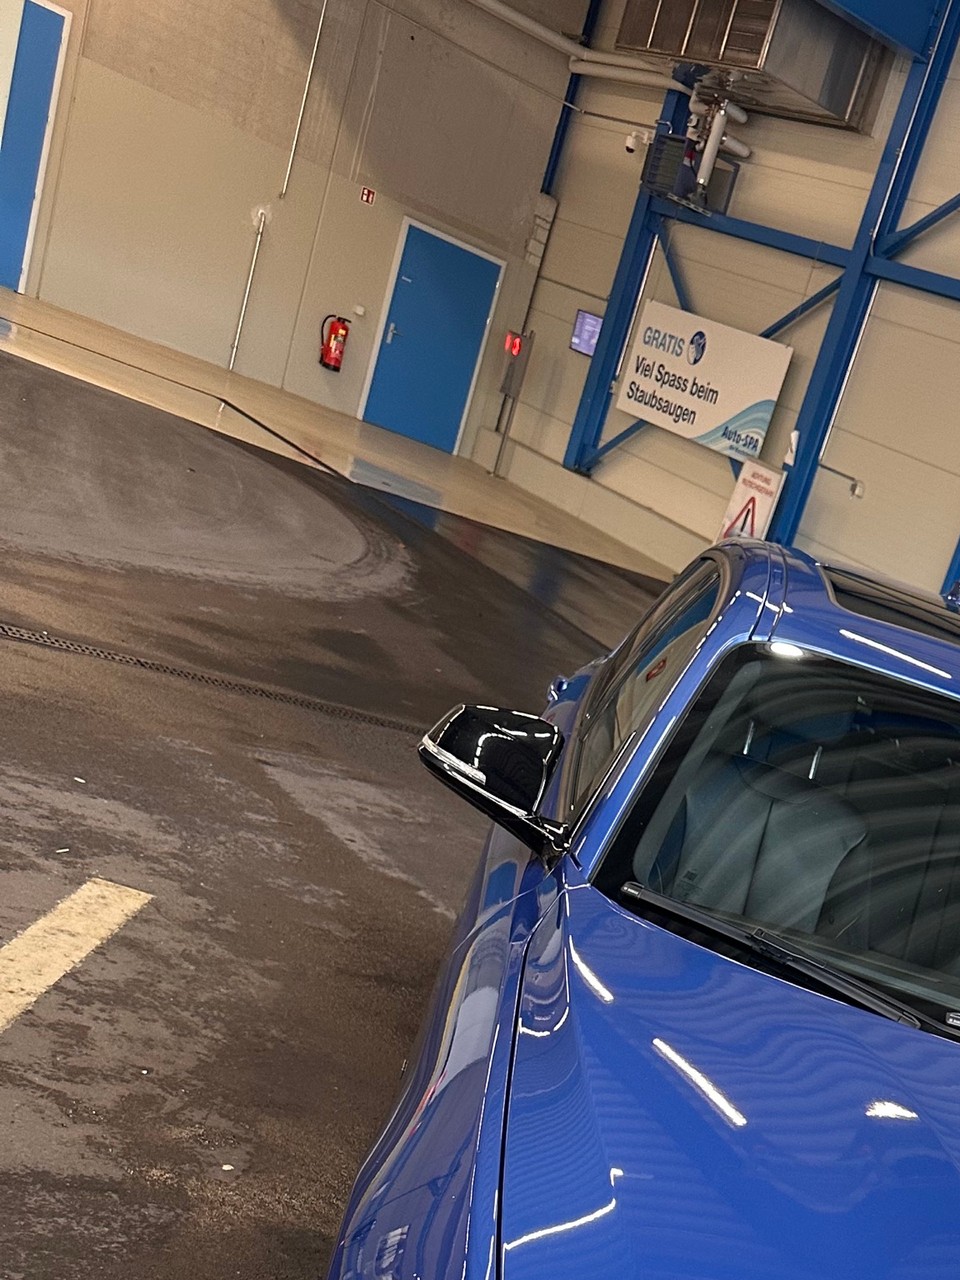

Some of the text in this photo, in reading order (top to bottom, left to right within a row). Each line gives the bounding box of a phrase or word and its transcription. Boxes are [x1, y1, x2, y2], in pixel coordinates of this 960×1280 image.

[643, 326, 685, 357] GRATIS
[635, 355, 719, 405] Viel Spass beim
[626, 381, 697, 426] Staubsaugen
[721, 426, 759, 451] Auto-SPA
